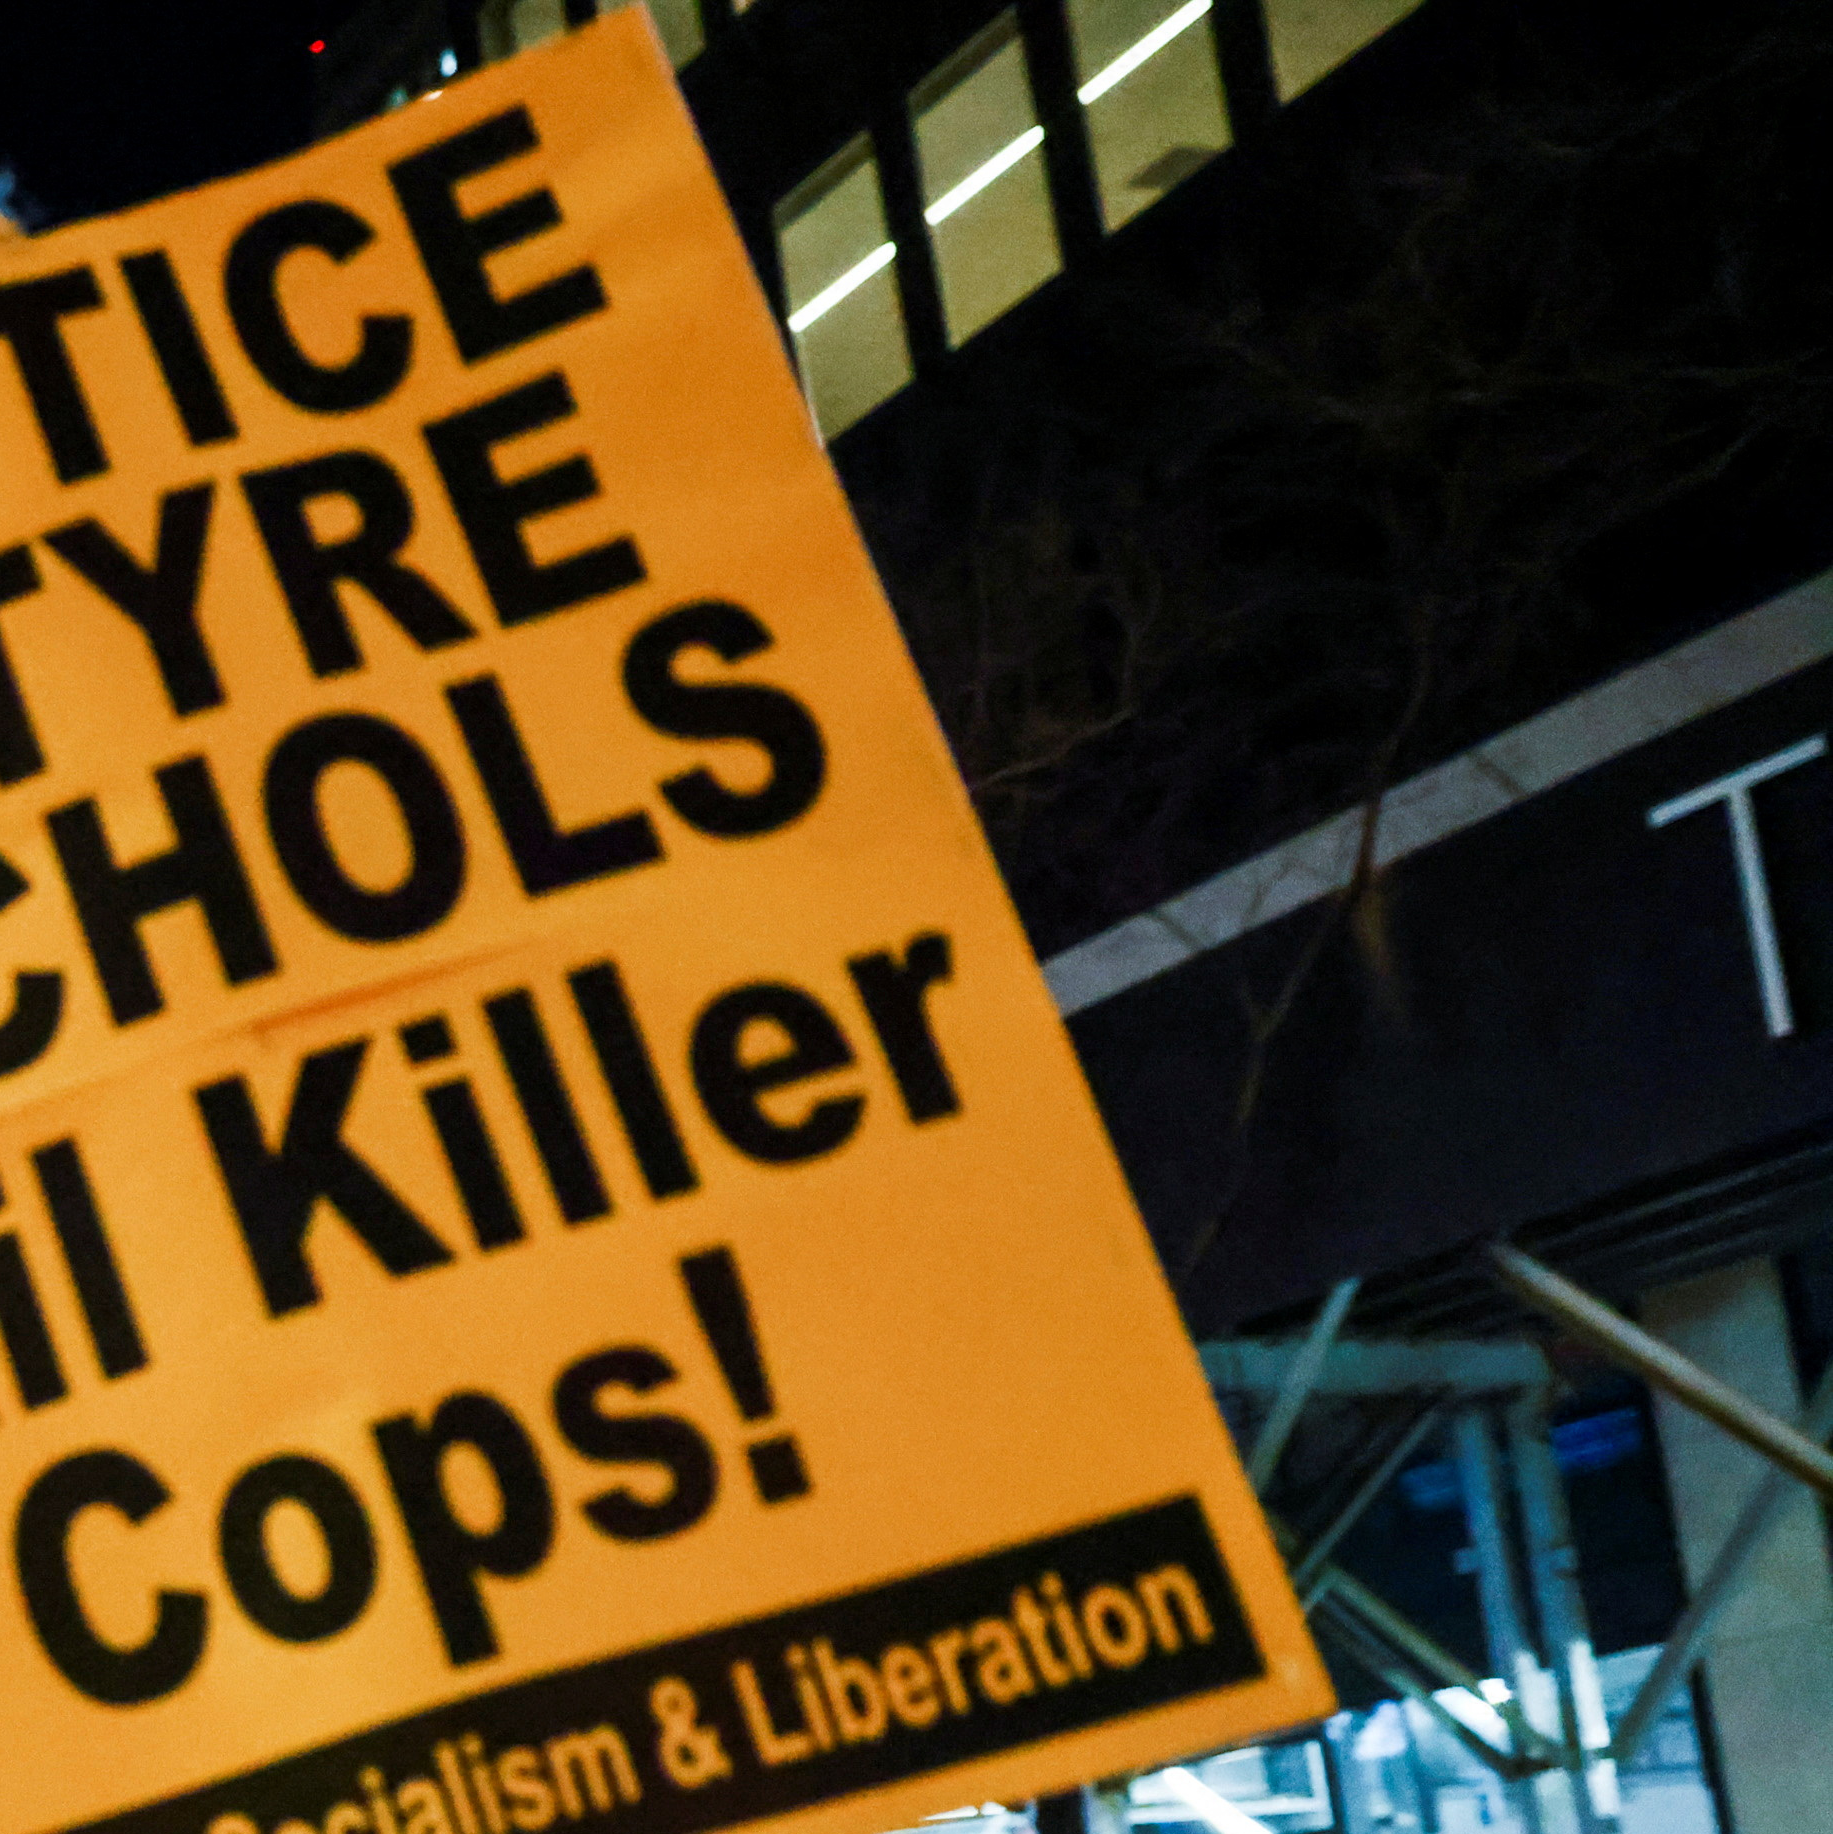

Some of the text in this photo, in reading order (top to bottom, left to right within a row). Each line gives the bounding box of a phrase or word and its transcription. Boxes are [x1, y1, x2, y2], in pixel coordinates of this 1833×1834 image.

[192, 928, 965, 1320] Killer
[12, 1247, 811, 1706] Cops!
[656, 1670, 730, 1781] &
[730, 1550, 1216, 1765] Liberation
